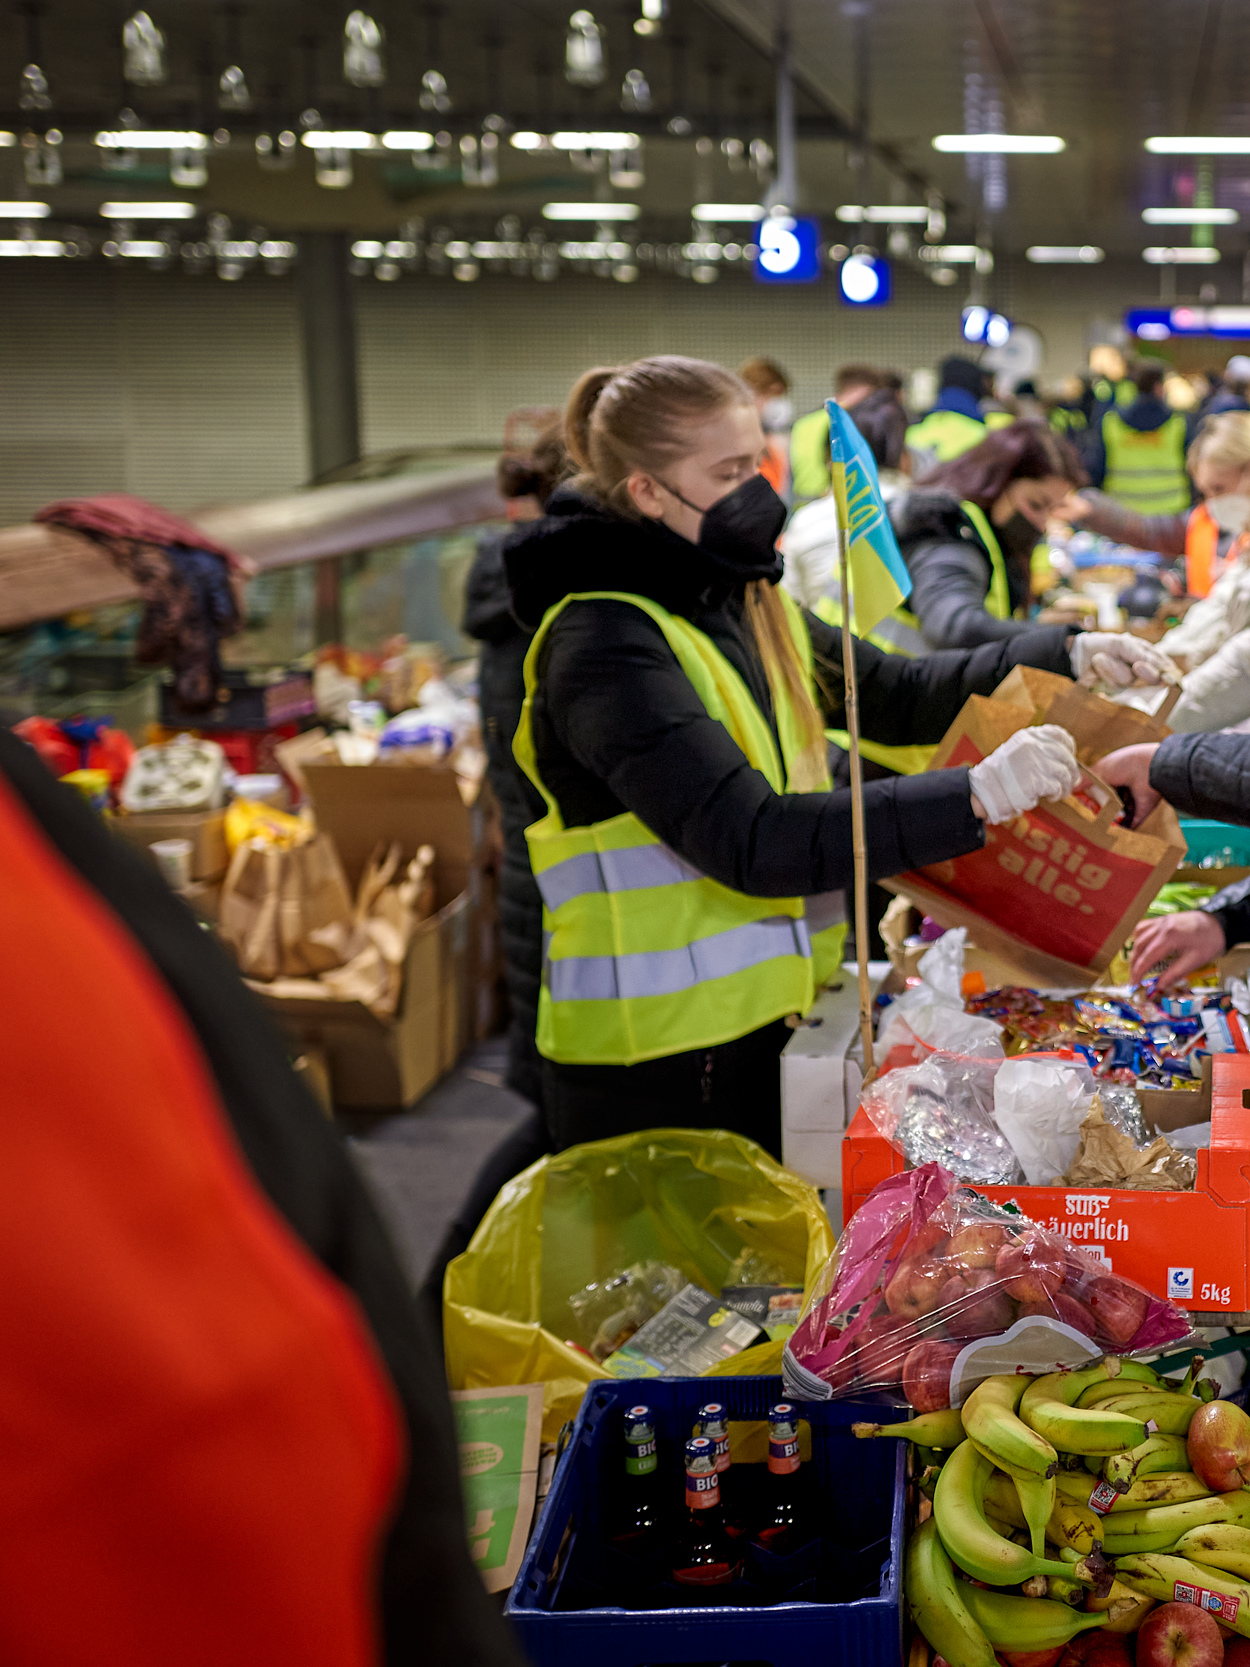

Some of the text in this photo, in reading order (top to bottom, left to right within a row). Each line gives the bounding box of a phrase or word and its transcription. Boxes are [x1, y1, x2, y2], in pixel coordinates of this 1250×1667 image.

[759, 215, 801, 274] 5
[1000, 815, 1112, 891] nstig
[997, 847, 1095, 915] alle.
[1200, 1283, 1231, 1305] 5kg
[784, 1439, 800, 1457] BI
[696, 1473, 719, 1491] BIO
